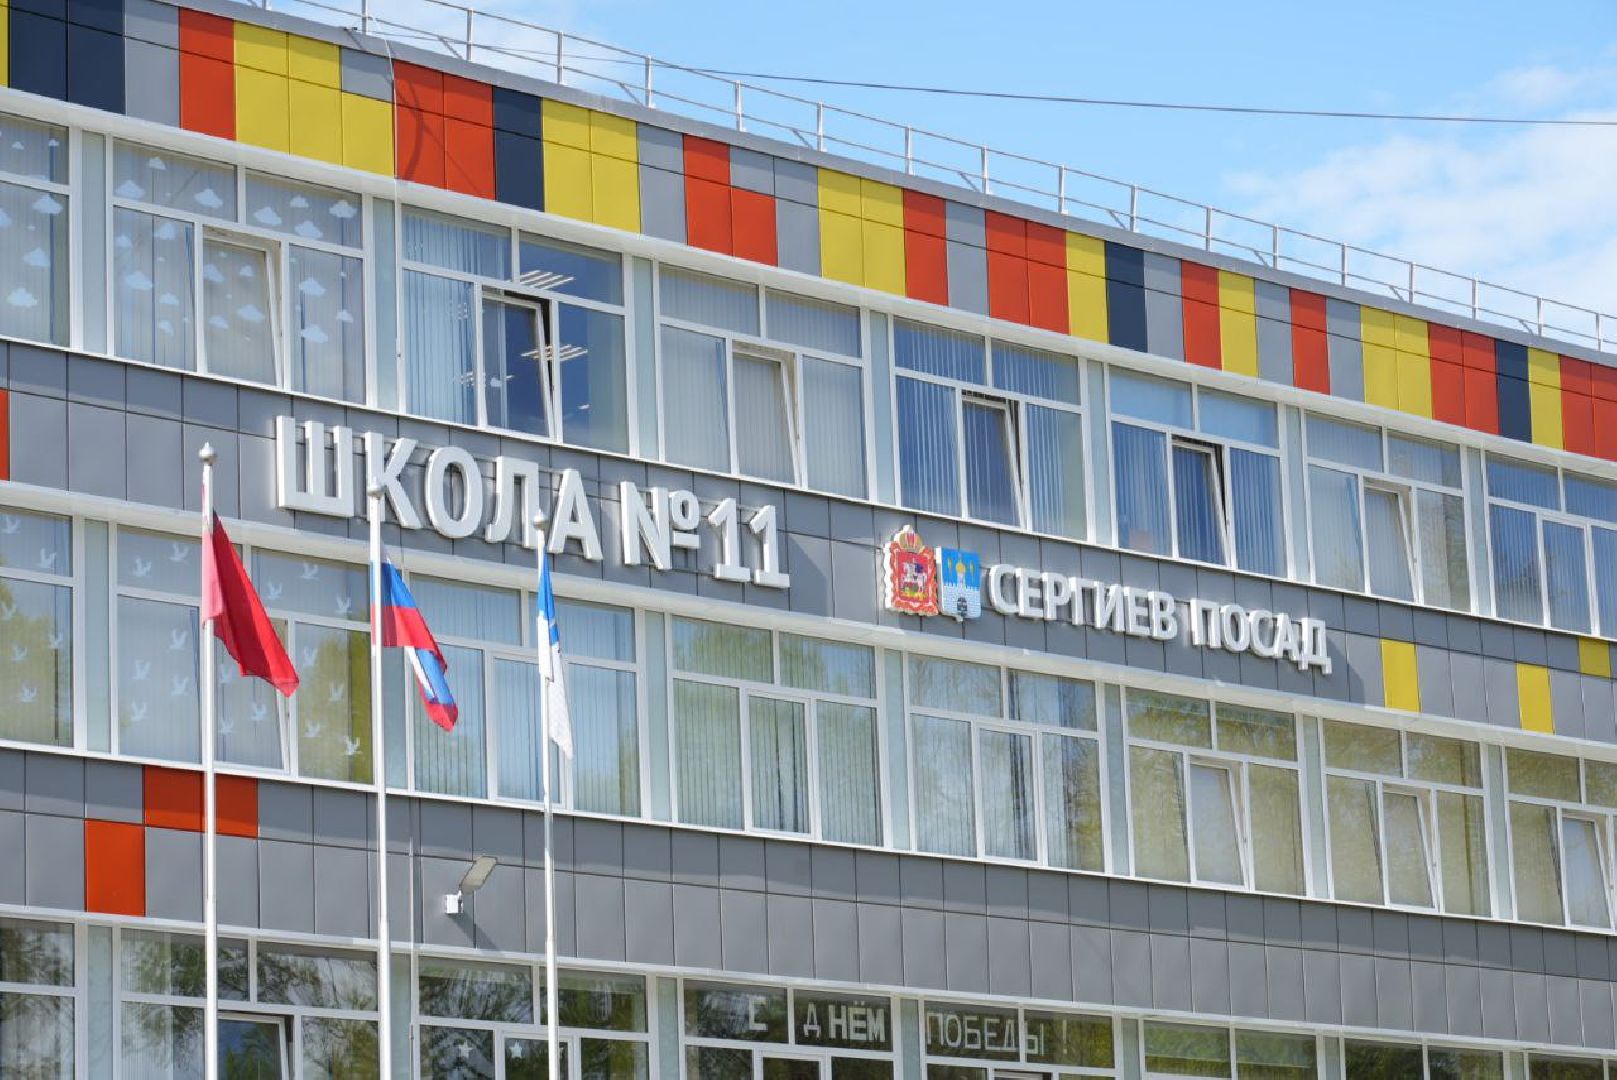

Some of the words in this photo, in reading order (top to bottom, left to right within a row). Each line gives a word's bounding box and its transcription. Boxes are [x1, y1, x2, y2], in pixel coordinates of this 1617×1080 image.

[276, 415, 603, 560] ШКОЛА
[989, 565, 1178, 641] СЕРГИЕВ
[1190, 599, 1332, 674] ПОСАД
